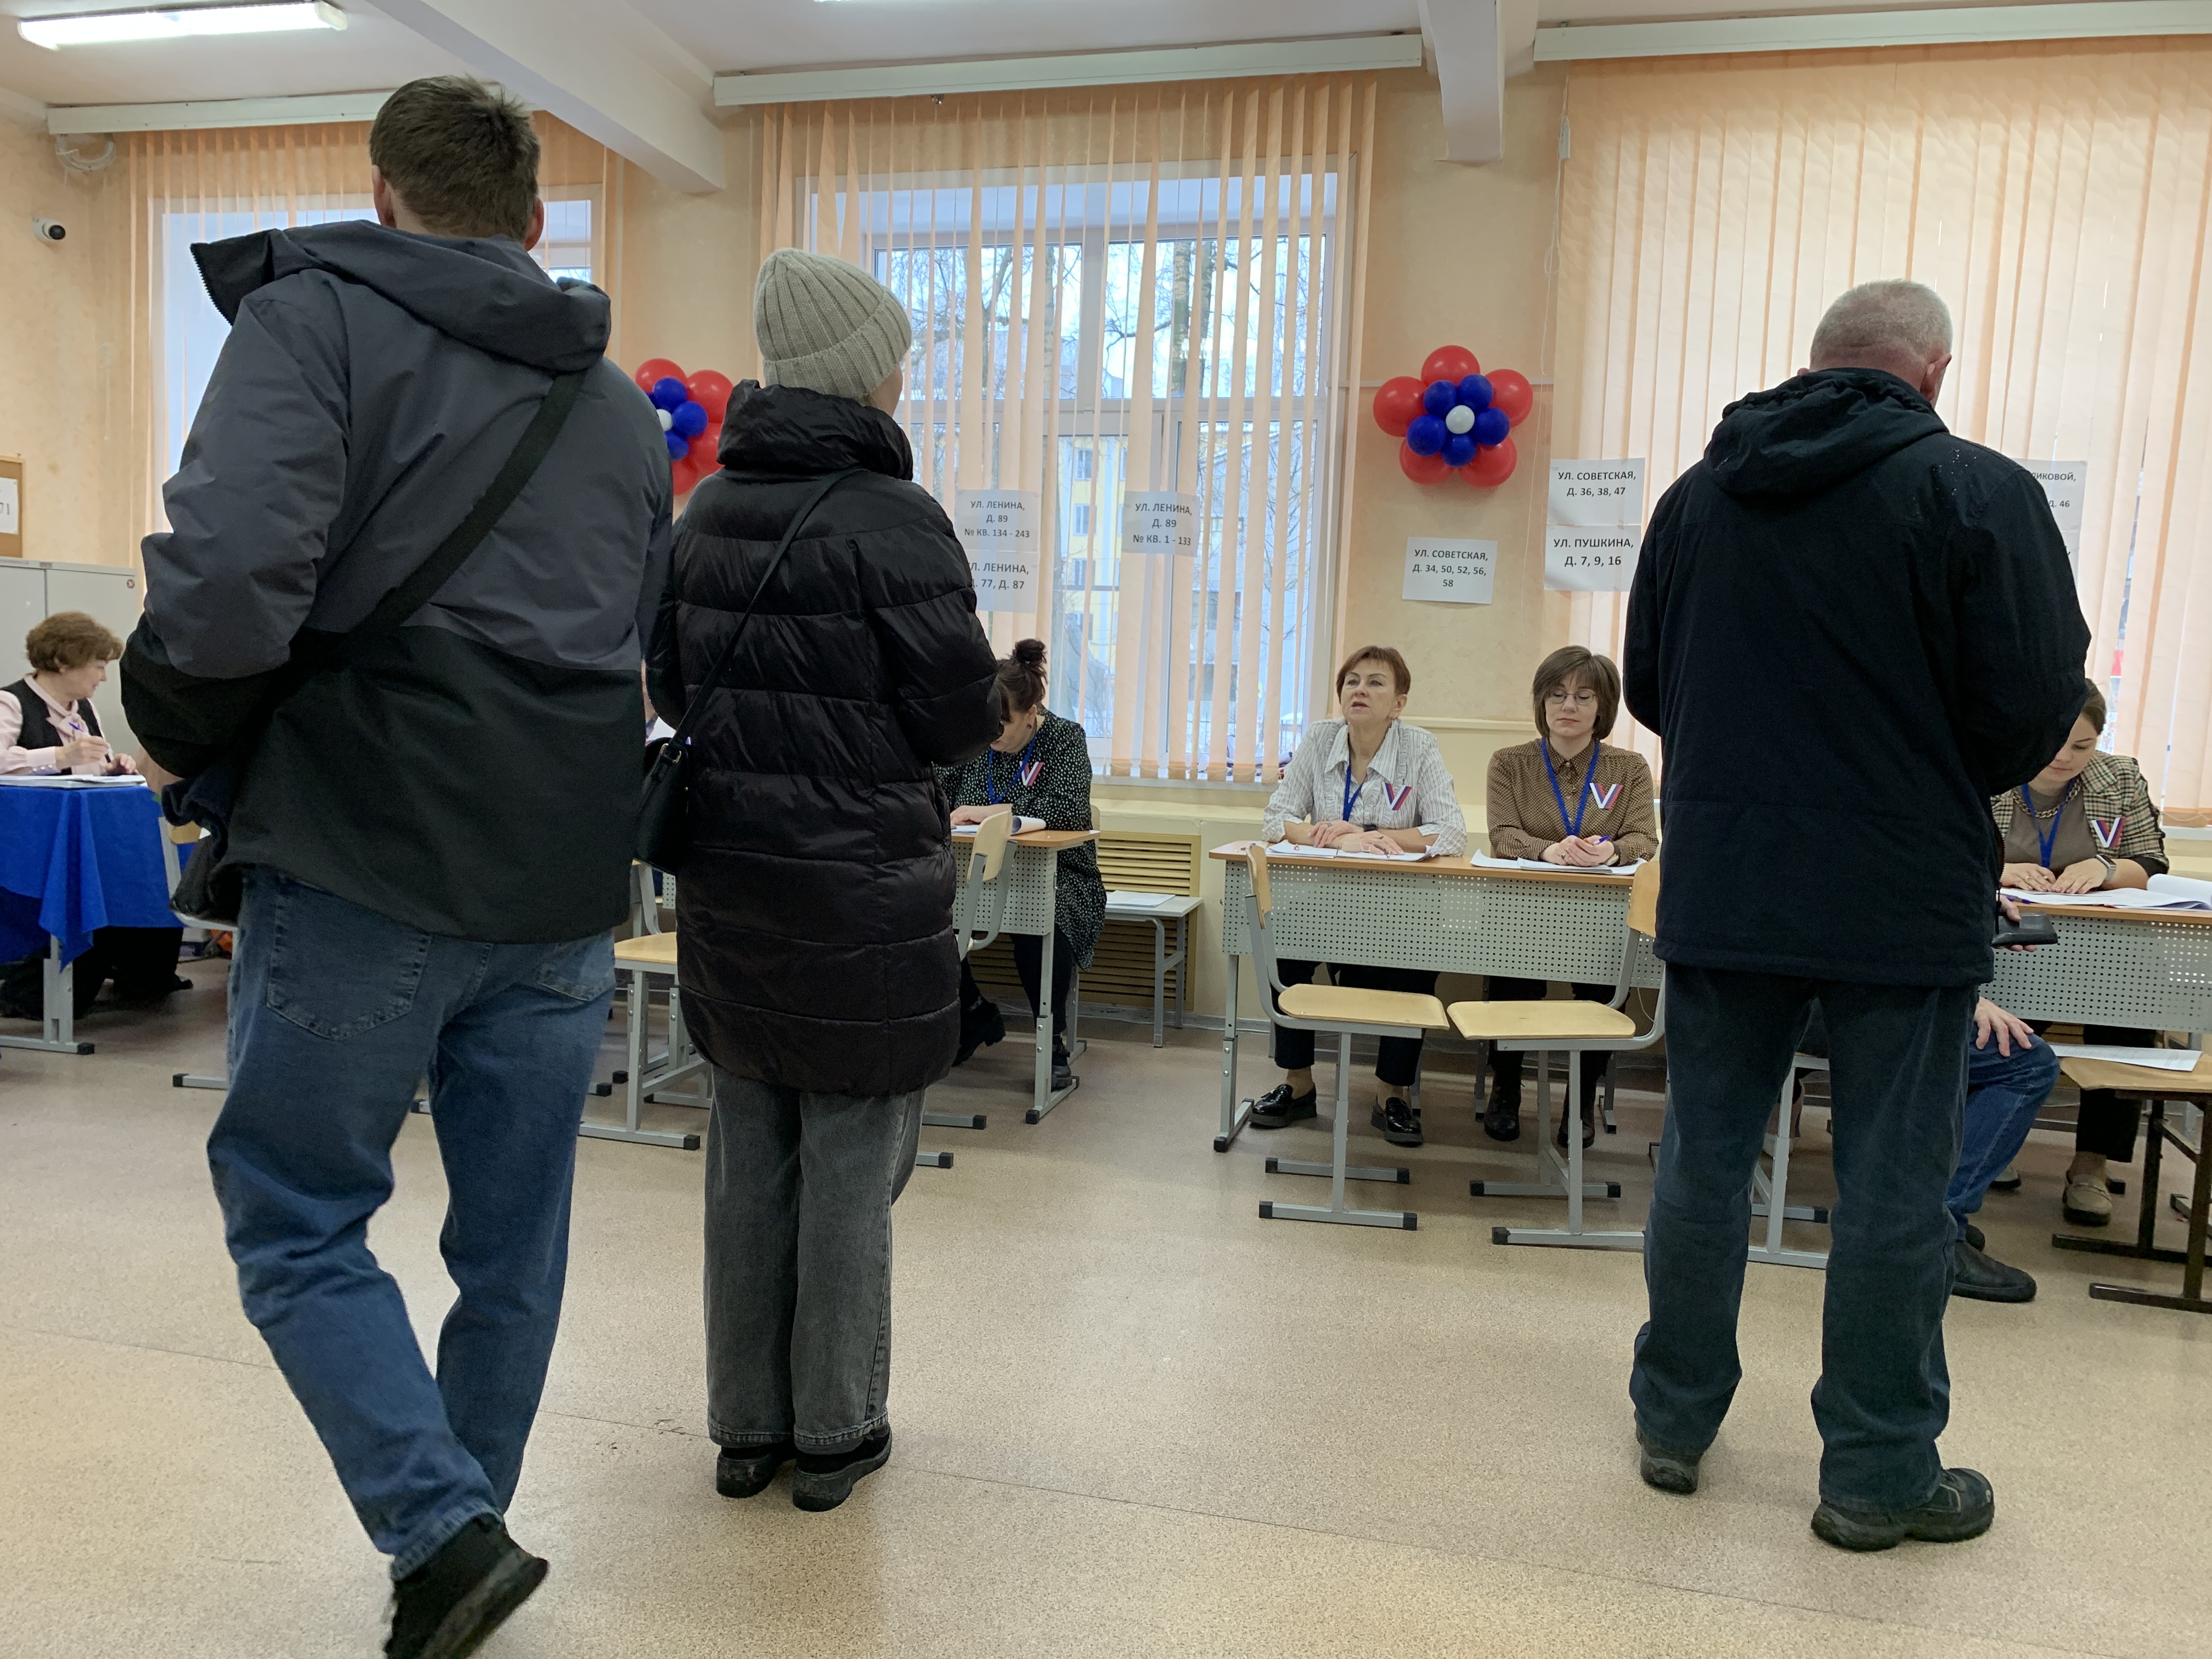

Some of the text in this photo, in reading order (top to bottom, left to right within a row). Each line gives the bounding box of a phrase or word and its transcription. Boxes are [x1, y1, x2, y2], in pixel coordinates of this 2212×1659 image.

[1558, 471, 1636, 481] УЛ. СОВЕТСКАЯ,
[1566, 487, 1626, 497] Д. 36, 38, 47
[986, 501, 1025, 511] ЛЕНИНА,
[1135, 503, 1192, 516] УЛ. ЛЕНИНА,
[2049, 500, 2057, 509] Д.
[986, 515, 1008, 523] Д. 89
[1152, 518, 1177, 529] Д. 89
[993, 529, 1007, 537] 134
[1015, 529, 1030, 538] 243
[1133, 534, 1144, 543] №
[1147, 534, 1161, 543] КВ.
[1164, 535, 1170, 544] 1
[1178, 536, 1191, 546] 133
[1554, 538, 1634, 549] УЛ. ПУШКИНА,
[1414, 549, 1488, 562] УЛ. СОВЕТСКАЯ,
[1564, 556, 1621, 567] Д. 7, 9, 16
[968, 562, 1029, 575] Л. ЛЕНИНА,
[1412, 564, 1486, 577] Д. 34, 50, 52, 56,
[981, 579, 996, 589] 77,
[998, 579, 1009, 590] Д.
[1013, 580, 1025, 589] 87
[1442, 579, 1454, 587] 58
